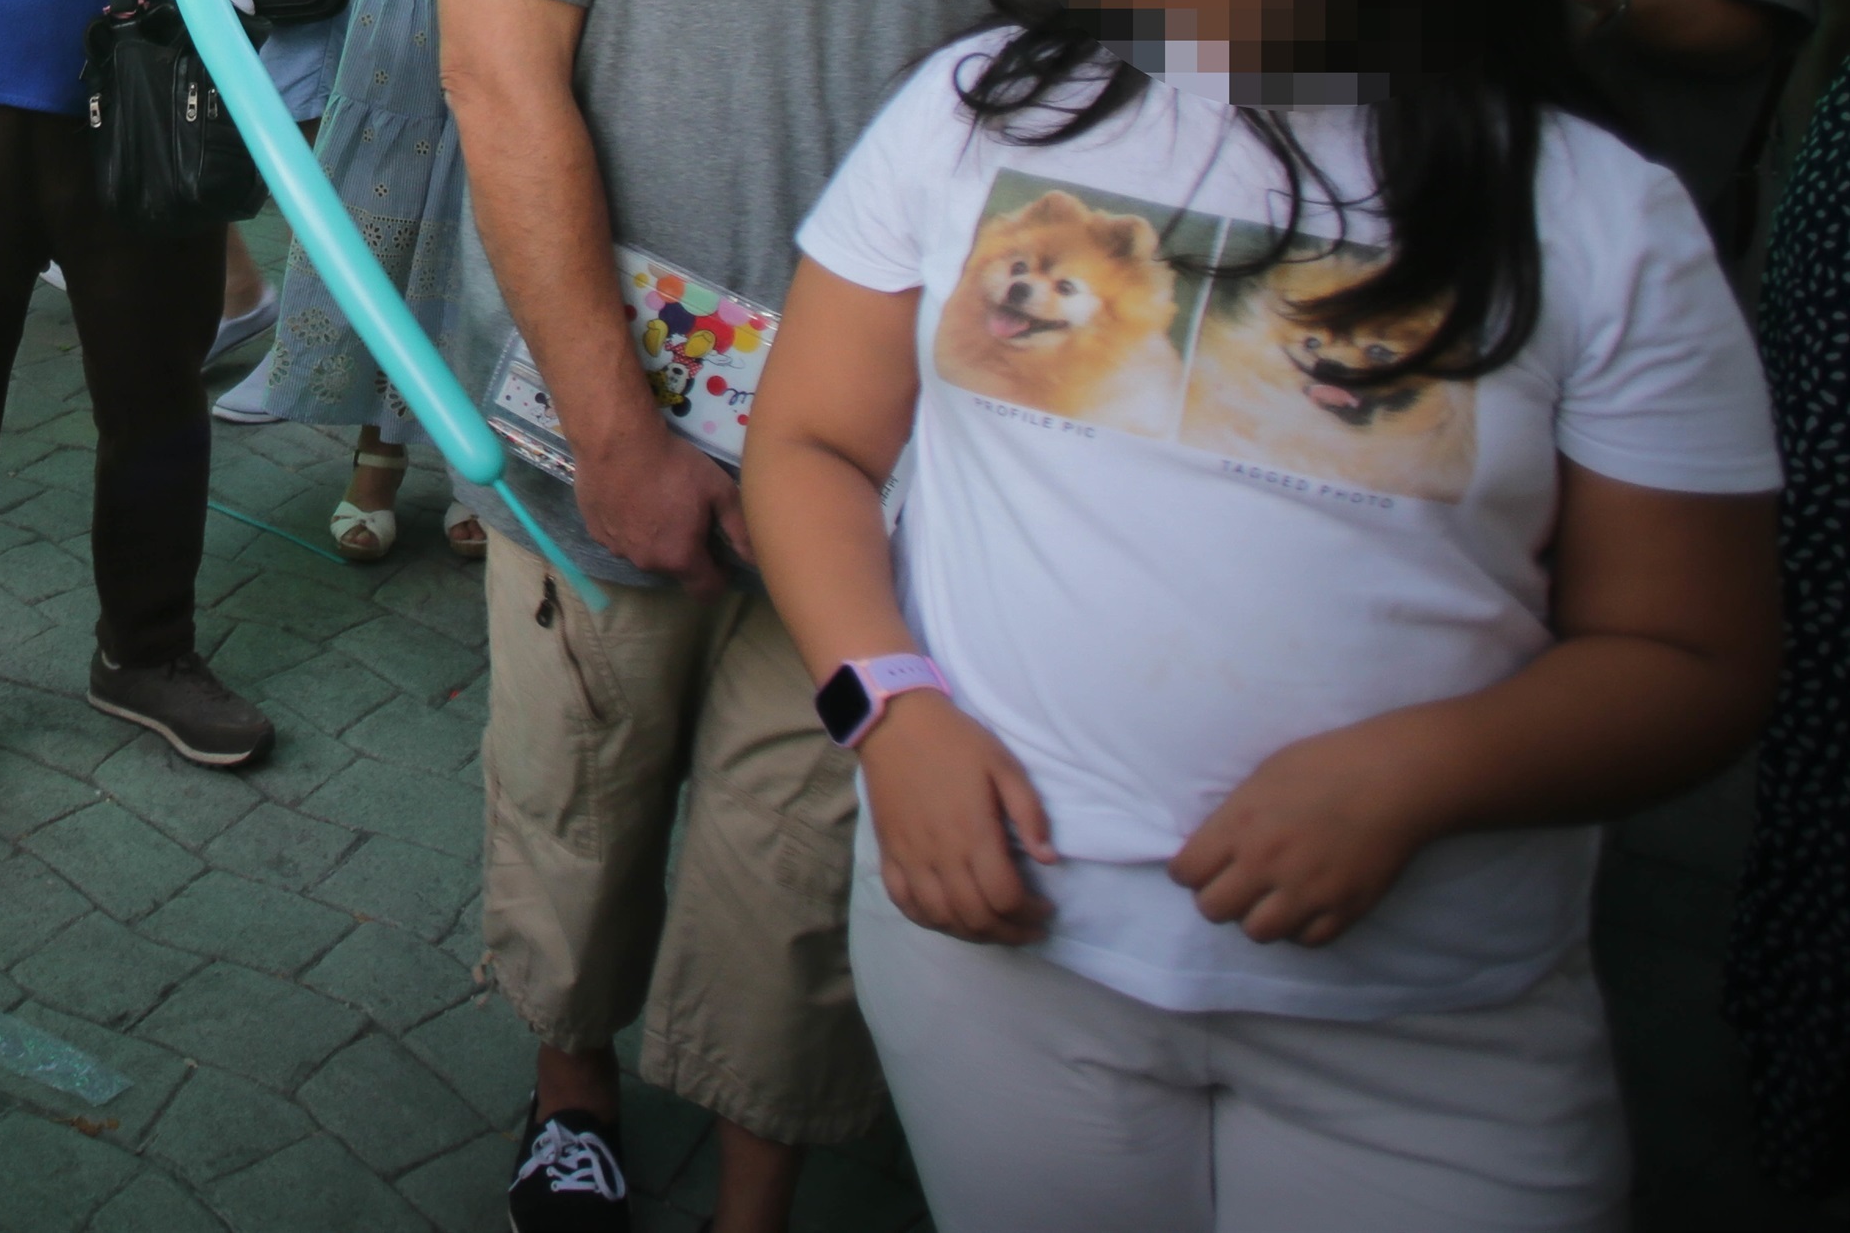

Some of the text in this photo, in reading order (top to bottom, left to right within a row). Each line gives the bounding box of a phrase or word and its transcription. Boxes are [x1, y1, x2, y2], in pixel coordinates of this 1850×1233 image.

[973, 397, 1096, 439] PROFILE PIC
[1221, 459, 1396, 510] TAGGED PHOTO
